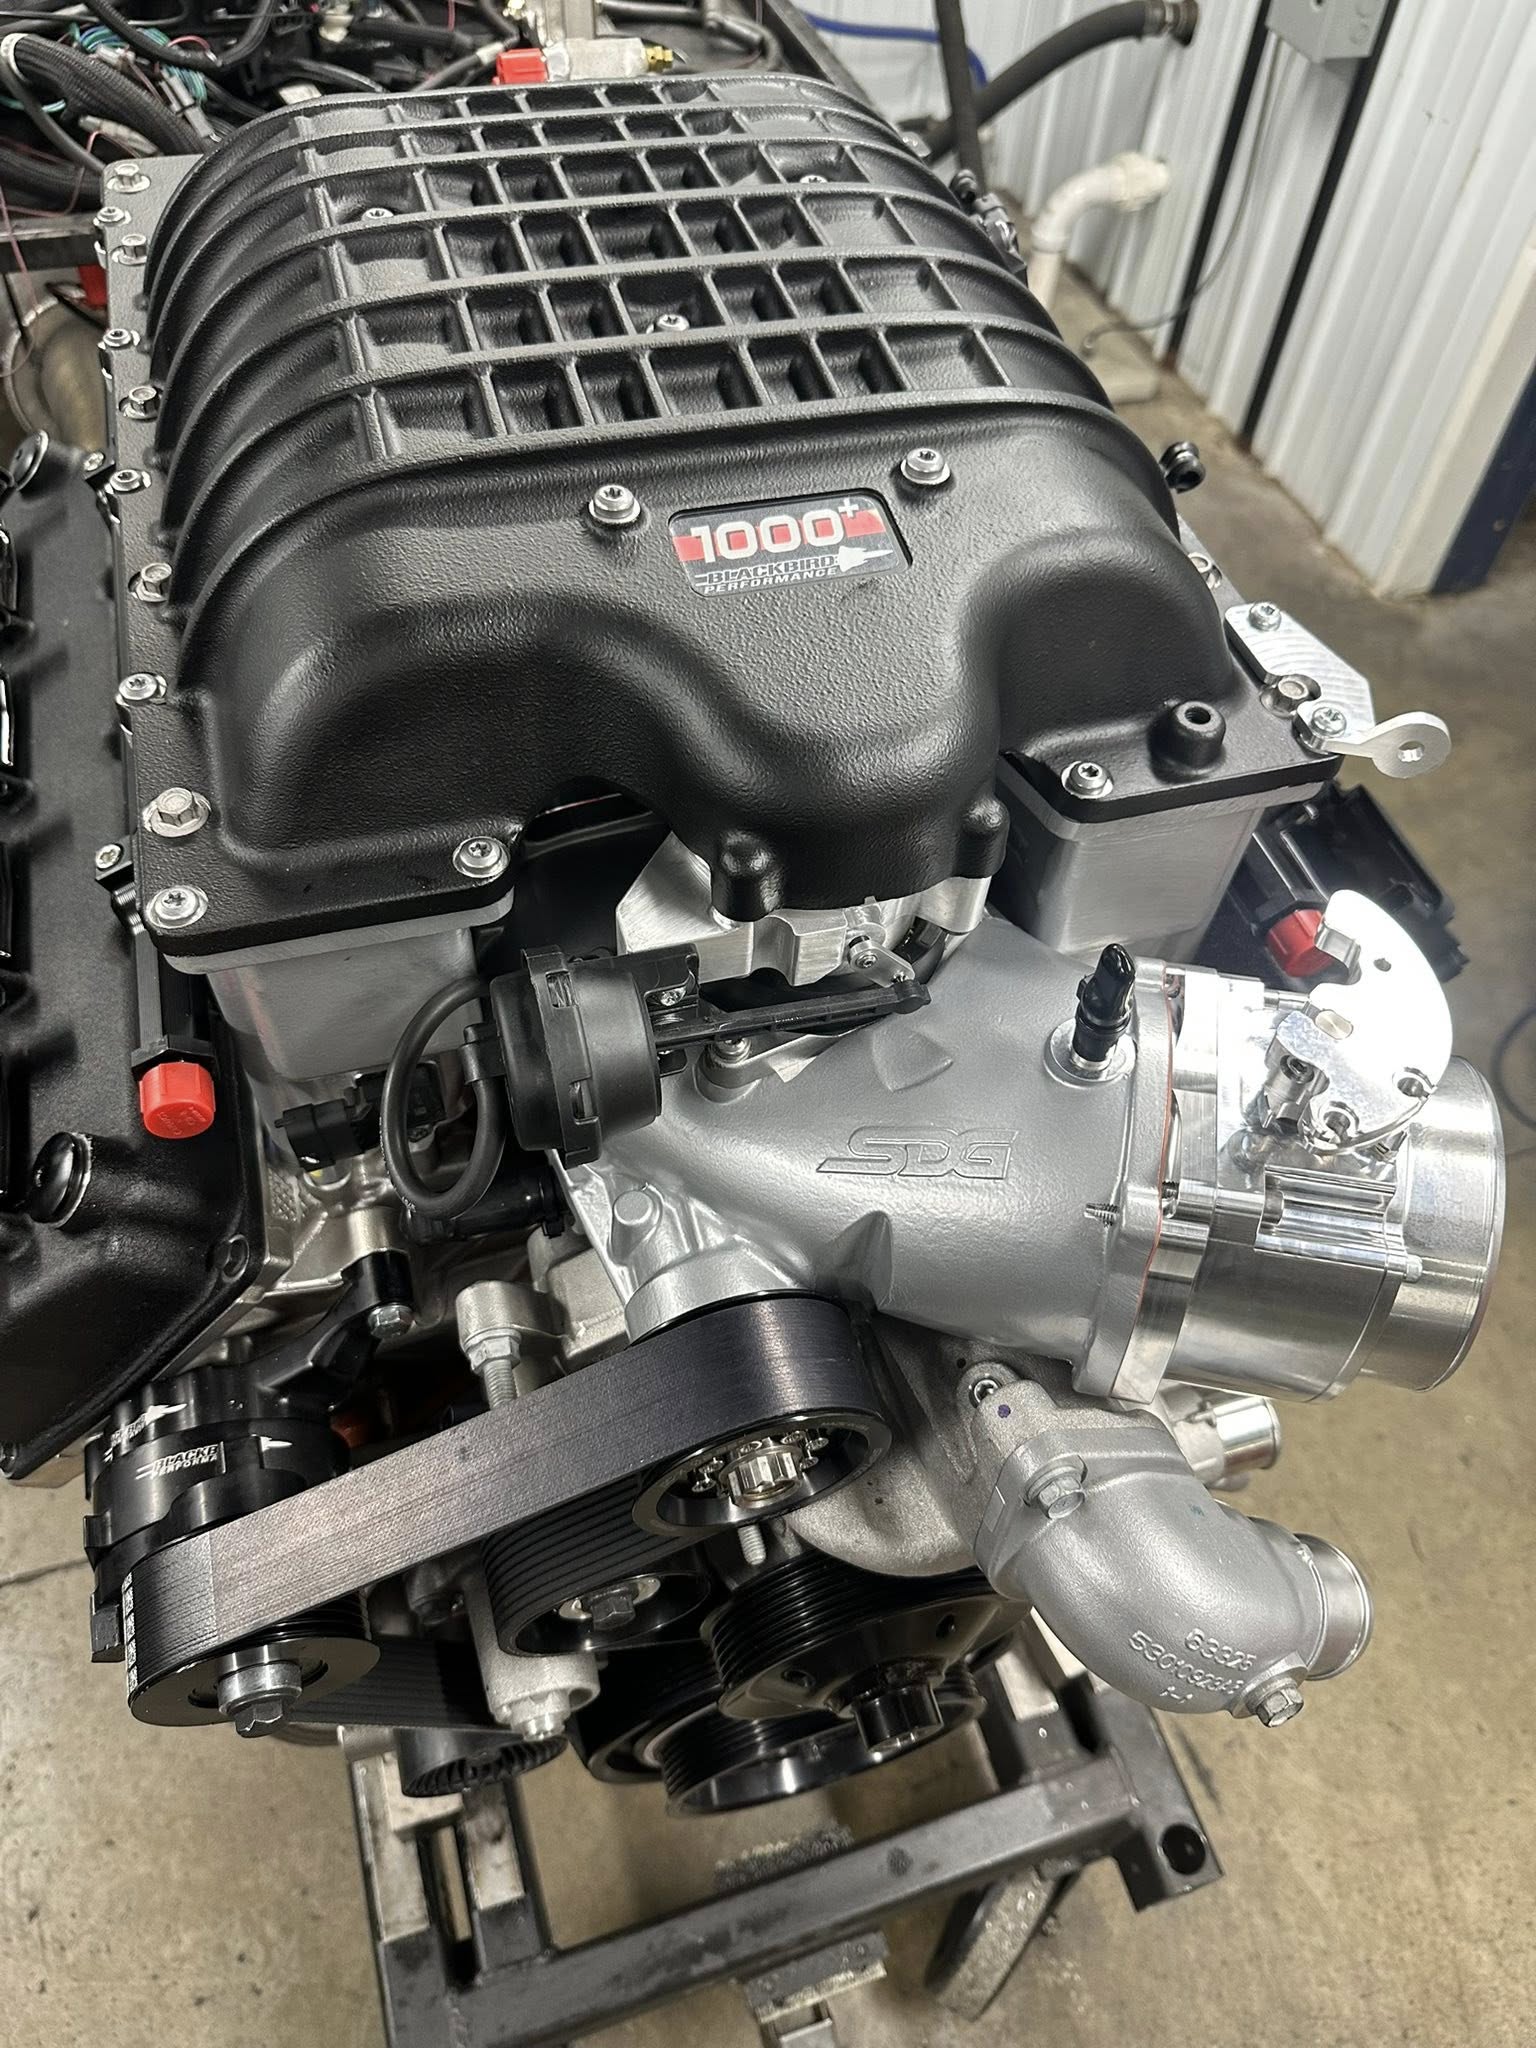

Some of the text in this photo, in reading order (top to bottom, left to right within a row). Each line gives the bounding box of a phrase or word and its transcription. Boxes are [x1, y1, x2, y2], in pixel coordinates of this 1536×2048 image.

[690, 498, 859, 563] 1000+
[703, 567, 838, 594] PERFORMANCE
[706, 554, 837, 585] BLACKBIRD
[816, 1126, 1019, 1180] SDG
